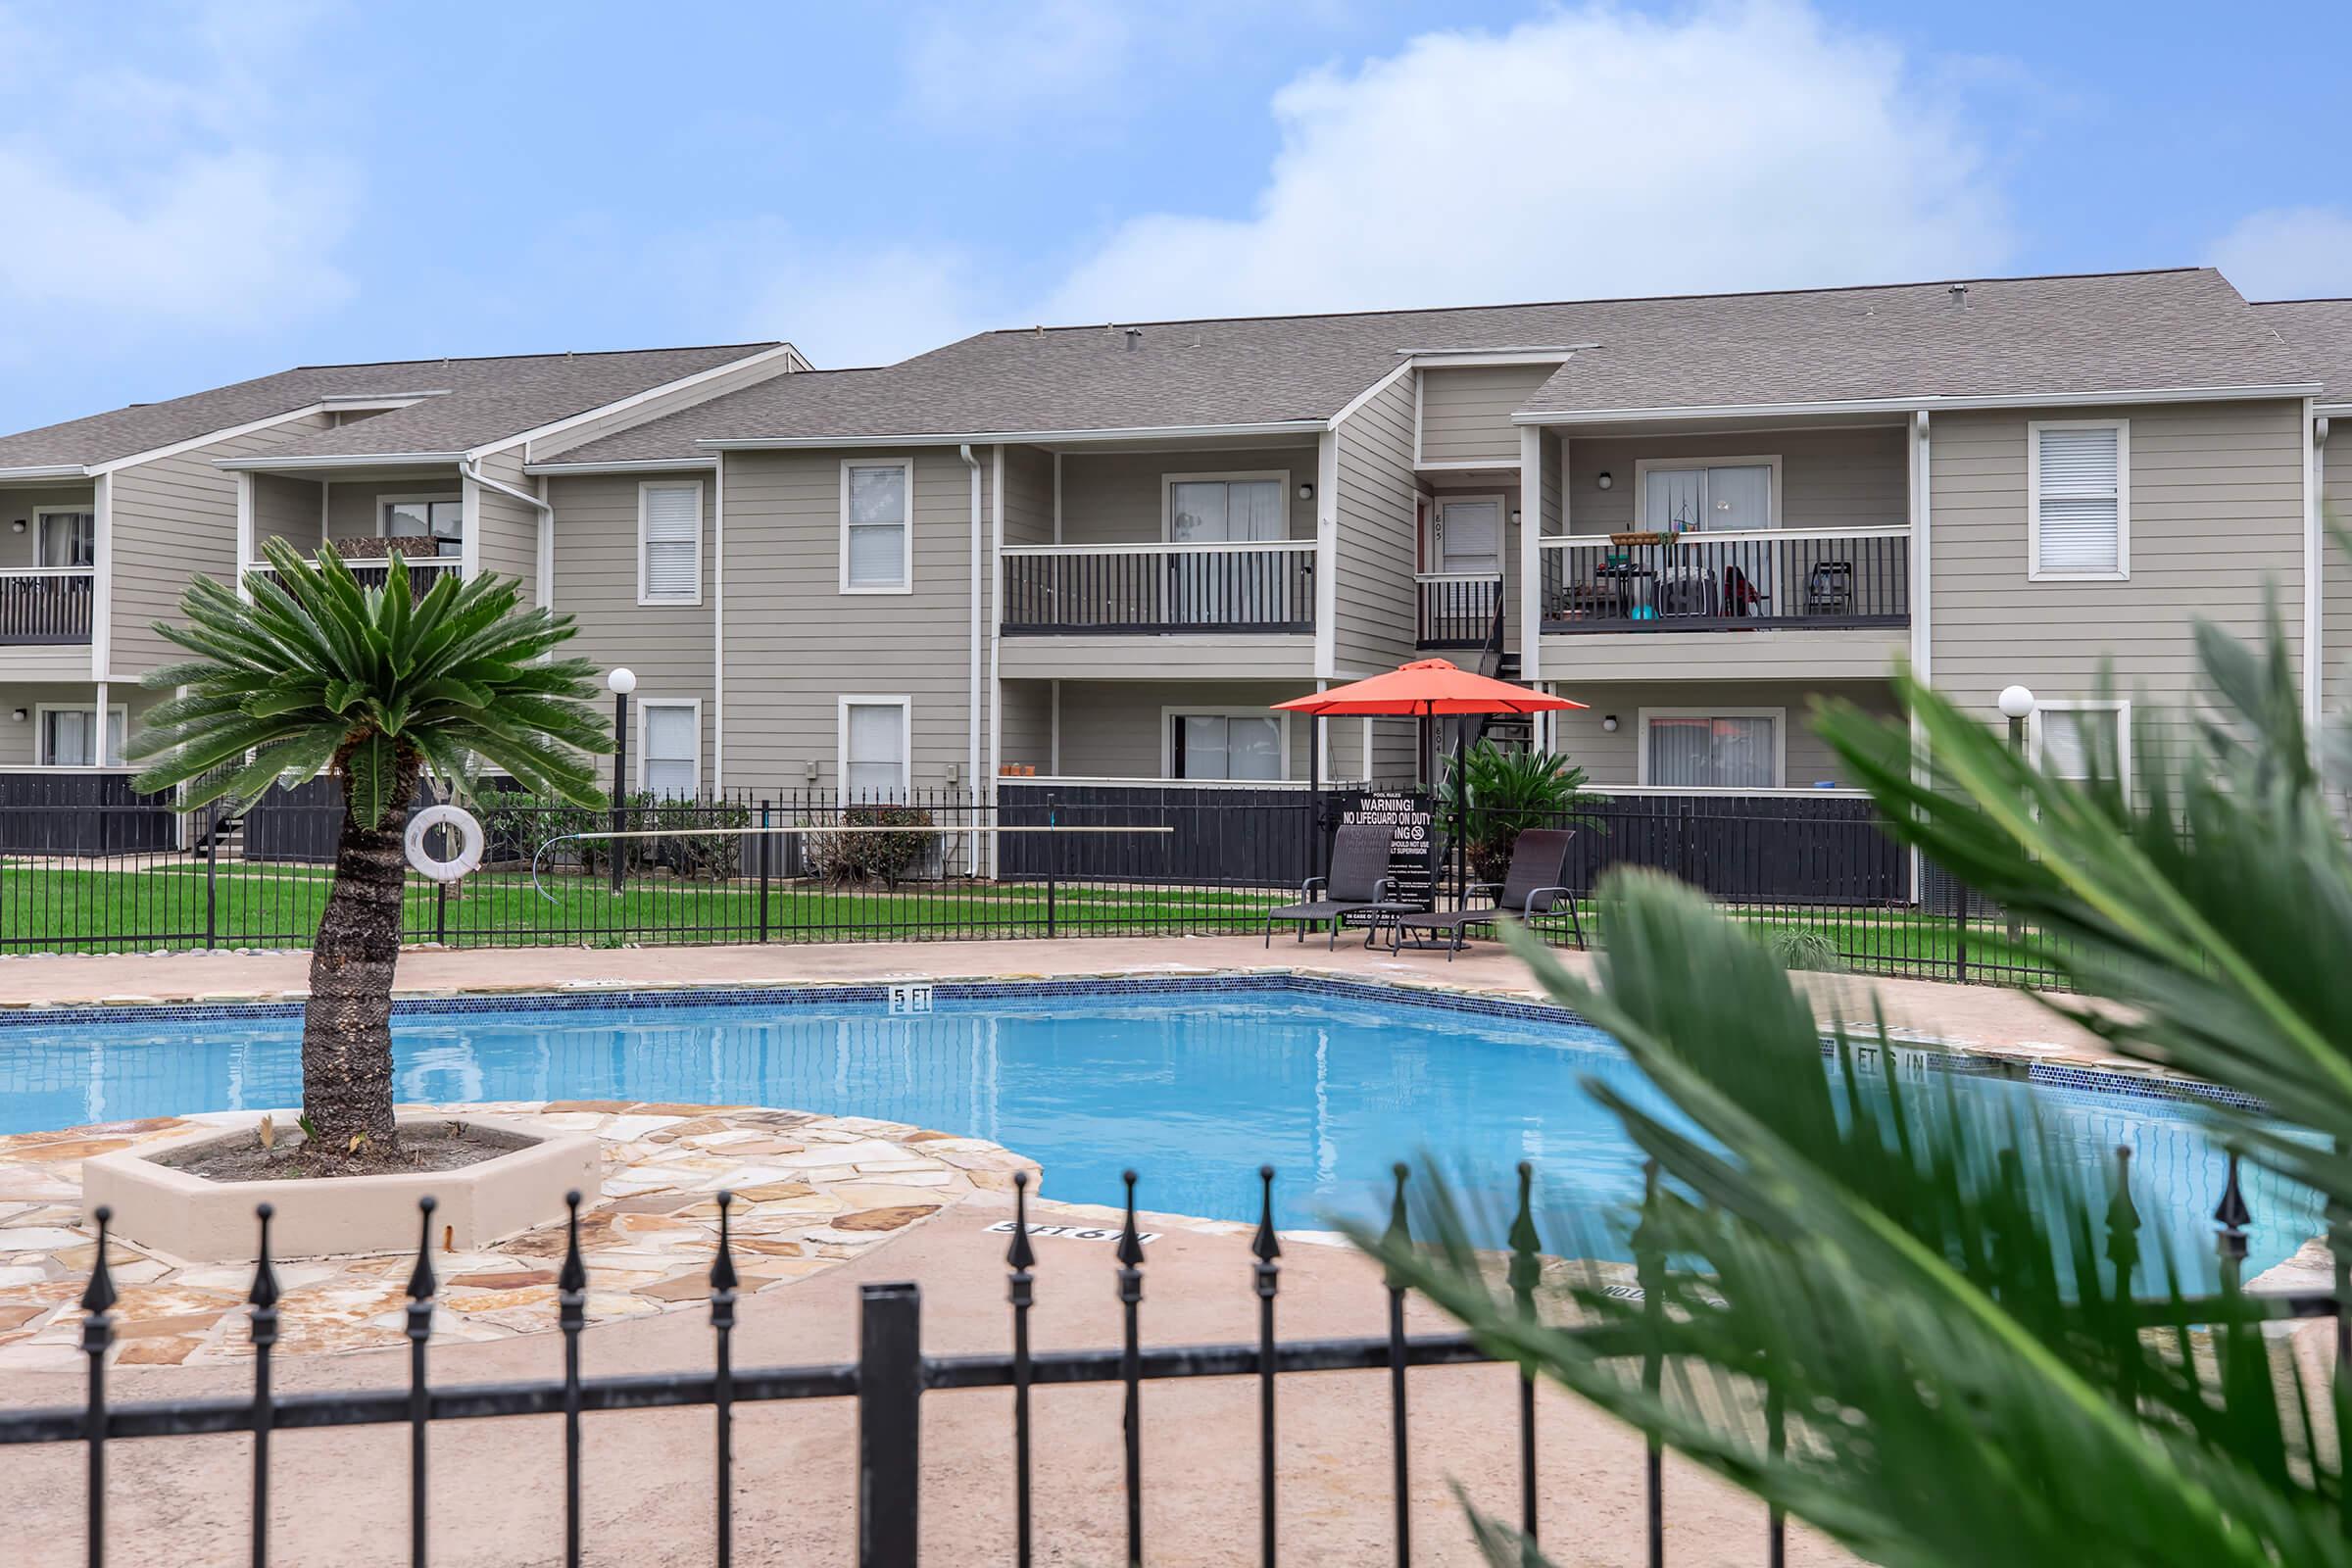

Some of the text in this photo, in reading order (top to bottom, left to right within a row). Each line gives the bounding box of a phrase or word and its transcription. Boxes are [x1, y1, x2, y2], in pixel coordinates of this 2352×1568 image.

[1360, 799, 1414, 811] WARNING!
[1344, 811, 1431, 825] NO LIFEGUARD ON DUTY
[894, 989, 905, 1004] 5
[1906, 1053, 1924, 1069] IN
[1029, 1225, 1076, 1235] FT
[1075, 1229, 1104, 1239] 6
